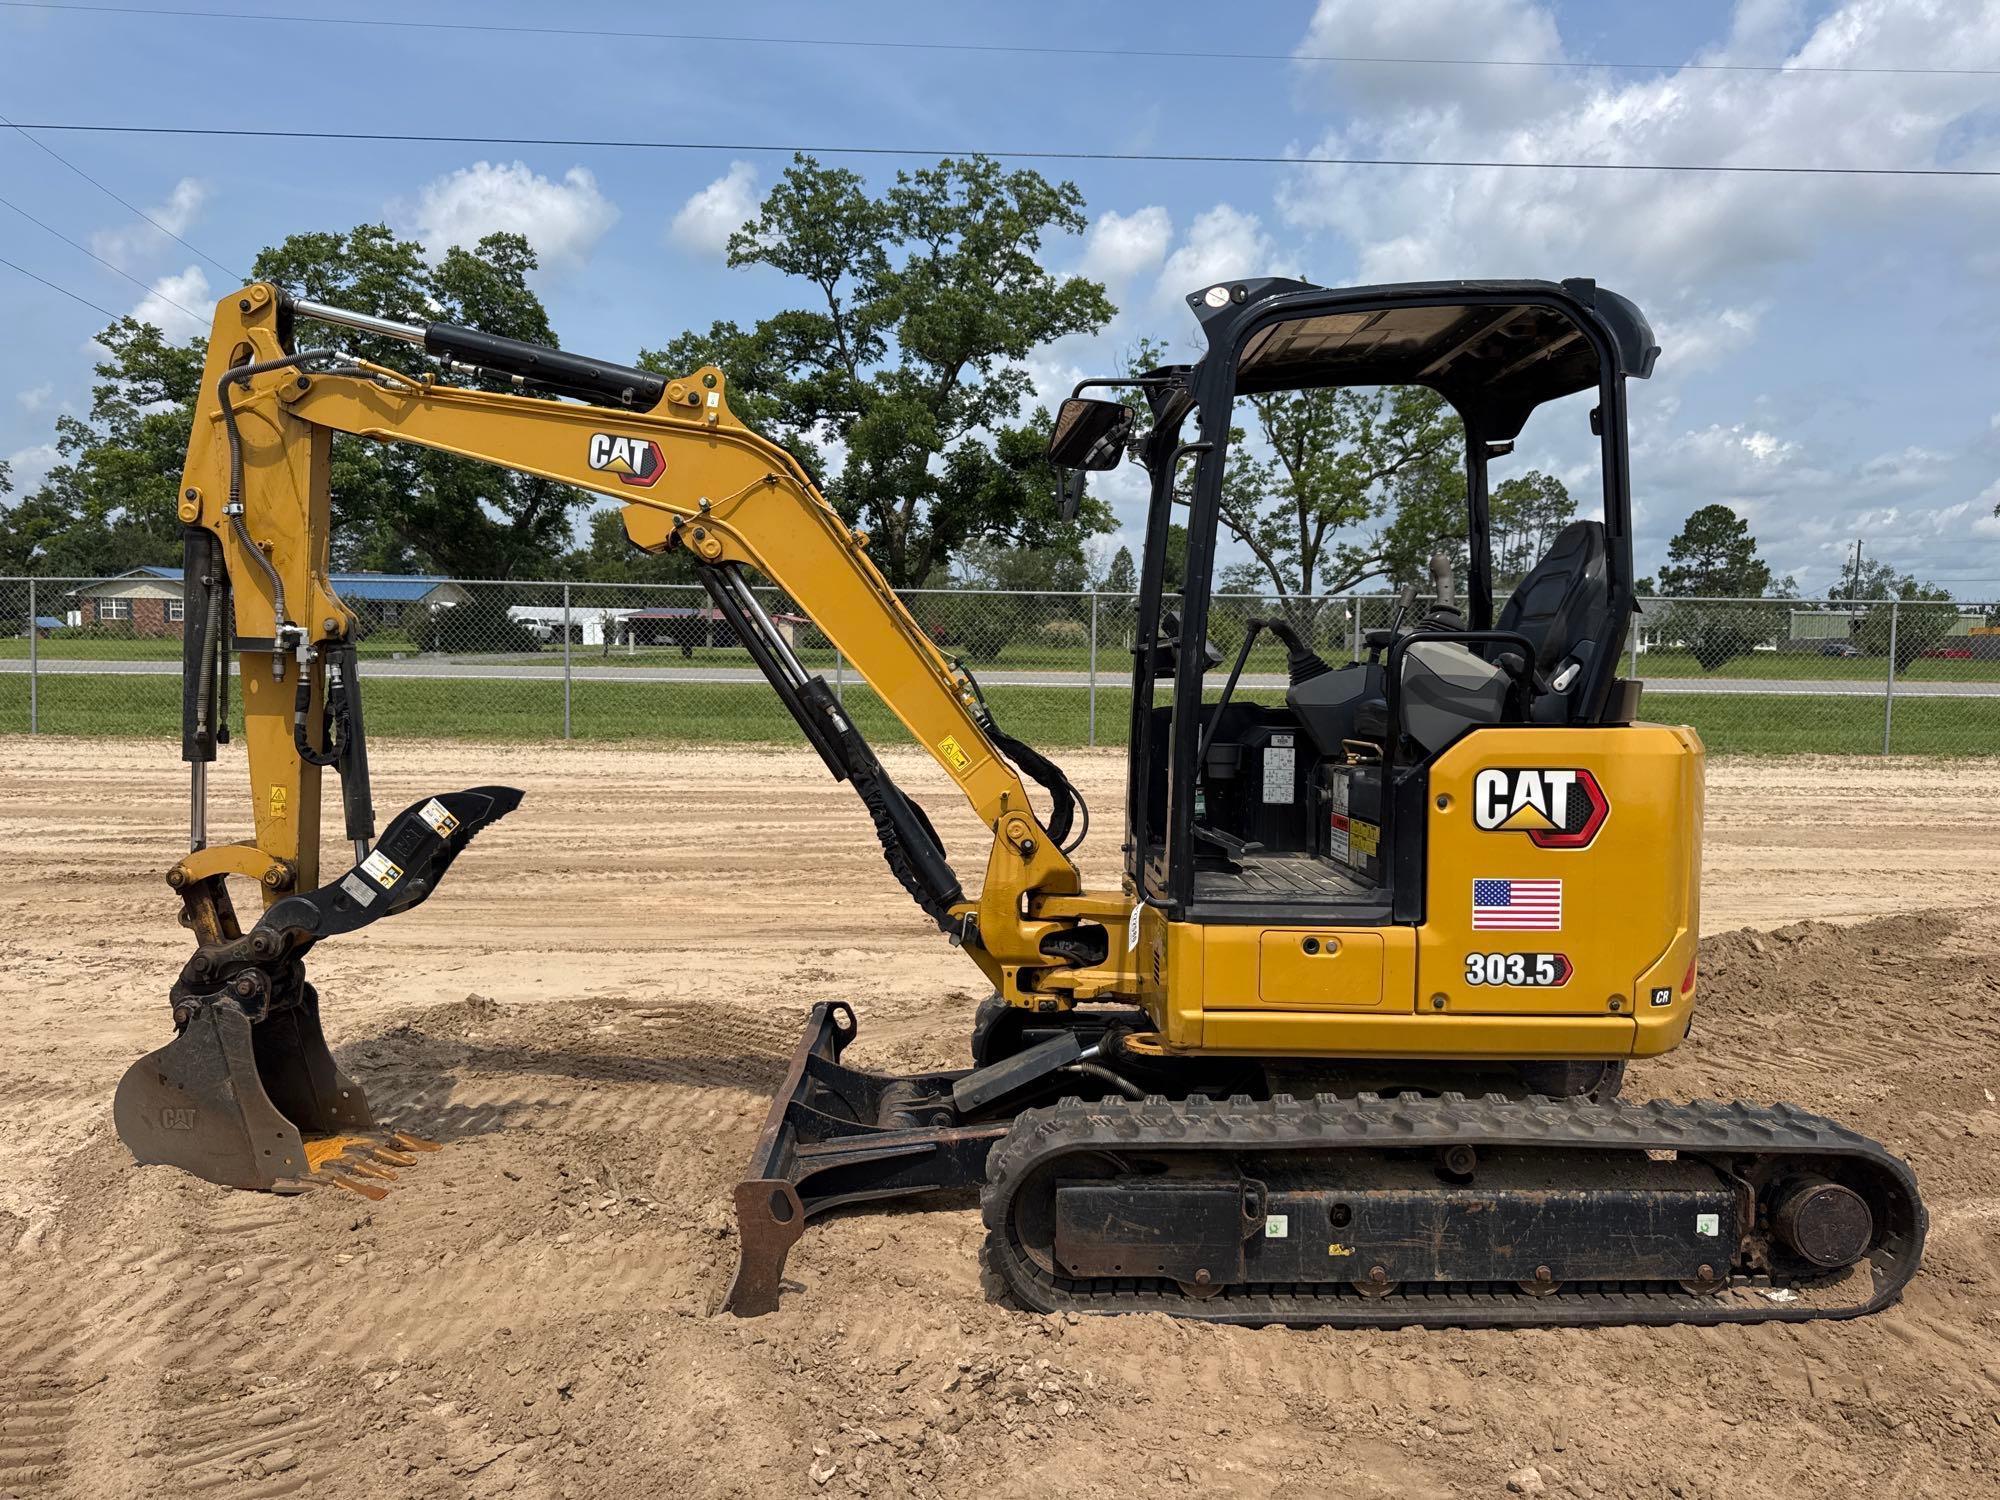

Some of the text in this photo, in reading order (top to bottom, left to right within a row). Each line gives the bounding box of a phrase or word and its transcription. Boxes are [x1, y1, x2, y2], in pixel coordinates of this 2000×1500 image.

[590, 433, 649, 475] CAT
[1475, 768, 1576, 830] CAT
[1465, 953, 1555, 985] 303.5
[1655, 990, 1669, 1004] CR
[162, 1108, 196, 1130] CAT
